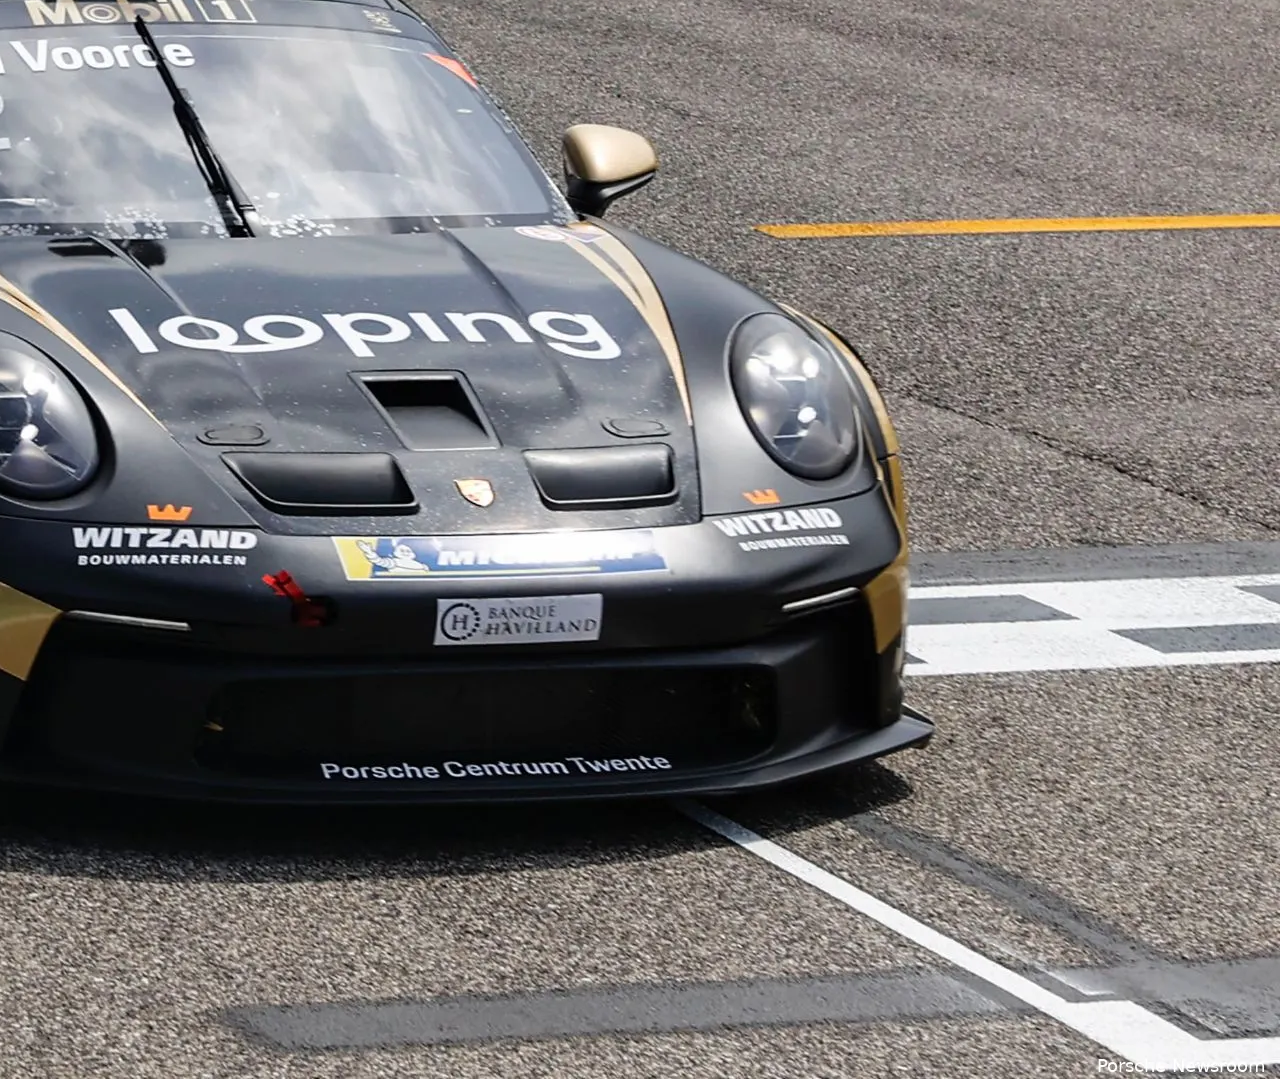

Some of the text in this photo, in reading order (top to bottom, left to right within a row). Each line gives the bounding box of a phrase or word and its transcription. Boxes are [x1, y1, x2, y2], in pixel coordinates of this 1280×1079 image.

[212, 0, 237, 20] 1
[108, 308, 622, 360] looping
[712, 508, 842, 537] WITZAND
[72, 527, 257, 550] WITZAND
[738, 534, 850, 552] BOUWMATERIALEN
[78, 554, 247, 566] BOUWMATERIALEN
[488, 604, 557, 620] BANQUE
[452, 614, 469, 631] H
[485, 618, 598, 636] HAVILLAND
[320, 755, 672, 780] Porsche Centrum Twente
